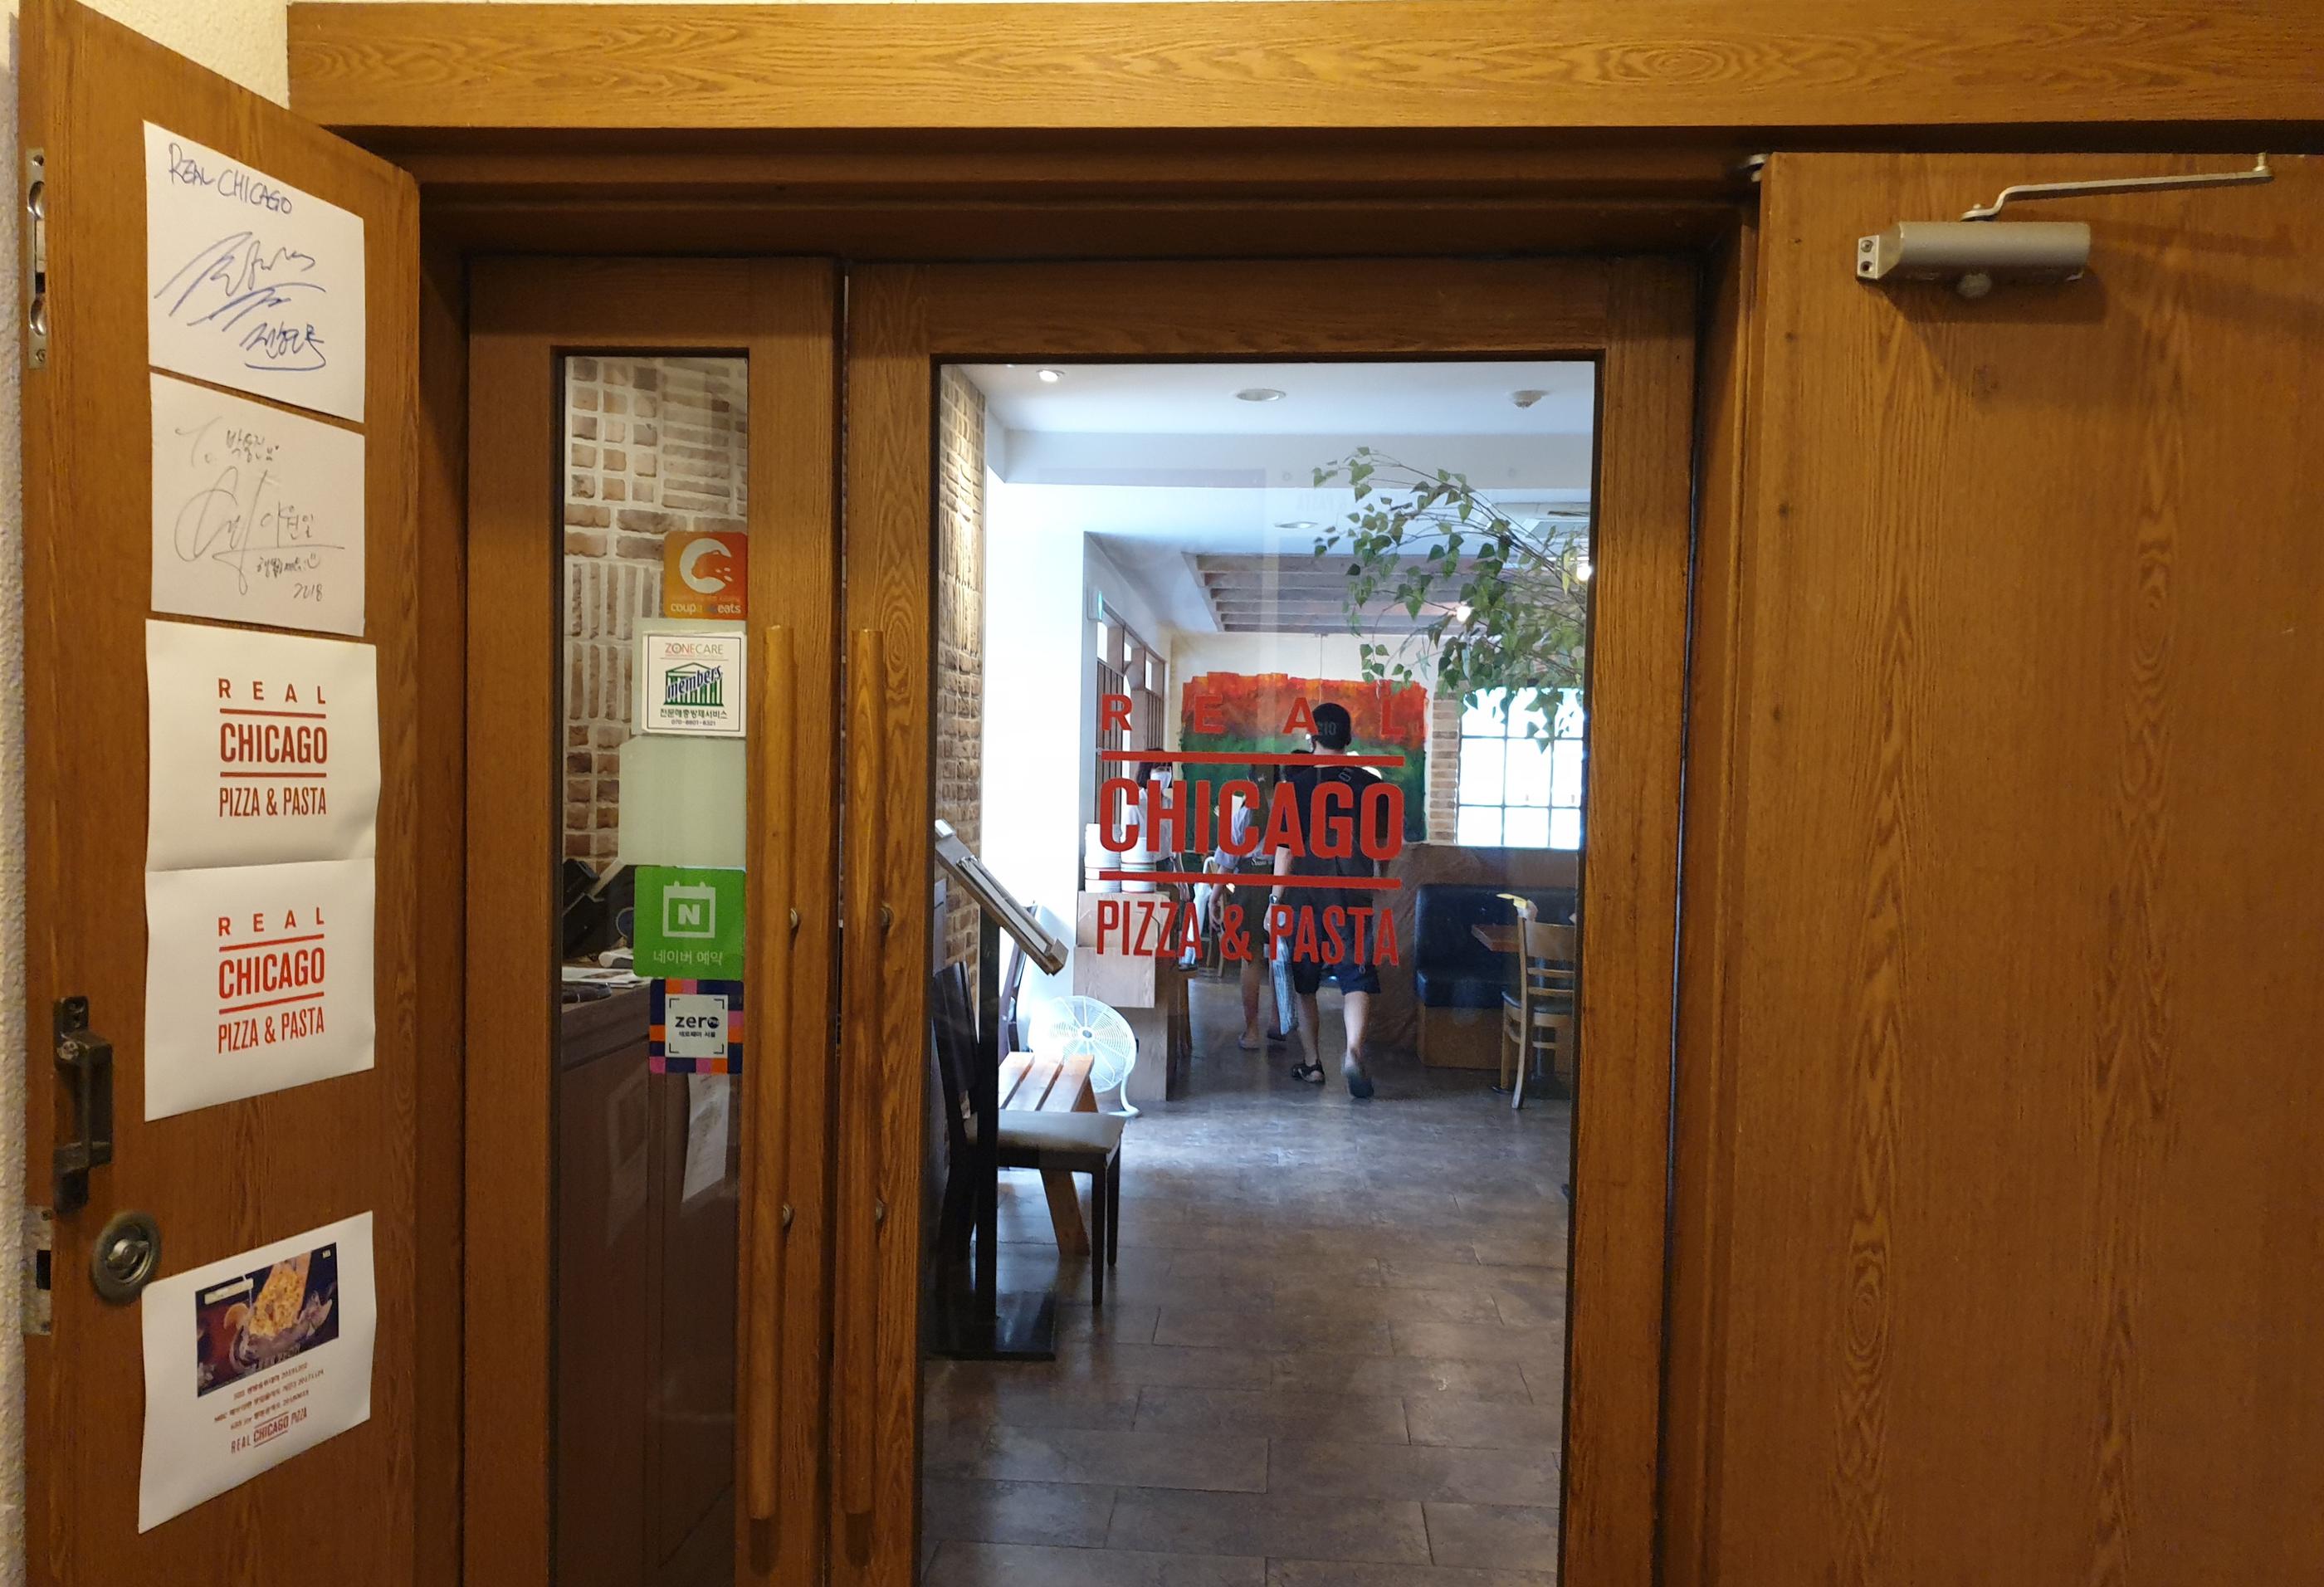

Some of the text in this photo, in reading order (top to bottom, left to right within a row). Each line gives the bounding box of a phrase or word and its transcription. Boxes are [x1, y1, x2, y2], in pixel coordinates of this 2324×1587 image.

[168, 143, 292, 214] REAL CHICAGO
[717, 603, 741, 614] eats
[217, 677, 326, 705] REAL
[666, 665, 723, 699] members
[1101, 693, 1406, 737] REAL
[220, 722, 328, 764] CHICAGO
[219, 787, 327, 818] PIZZA & PASTA
[1098, 776, 1405, 861] CHICAGO
[217, 906, 325, 937] REAL
[1096, 899, 1399, 967] PIZZA & PASTA
[218, 947, 325, 999] CHICAGO
[653, 950, 724, 966] 네이버 예약
[218, 1006, 325, 1054] PIZZA & PASTA
[231, 1434, 251, 1454] REAL
[253, 1414, 289, 1443] CHICAGO
